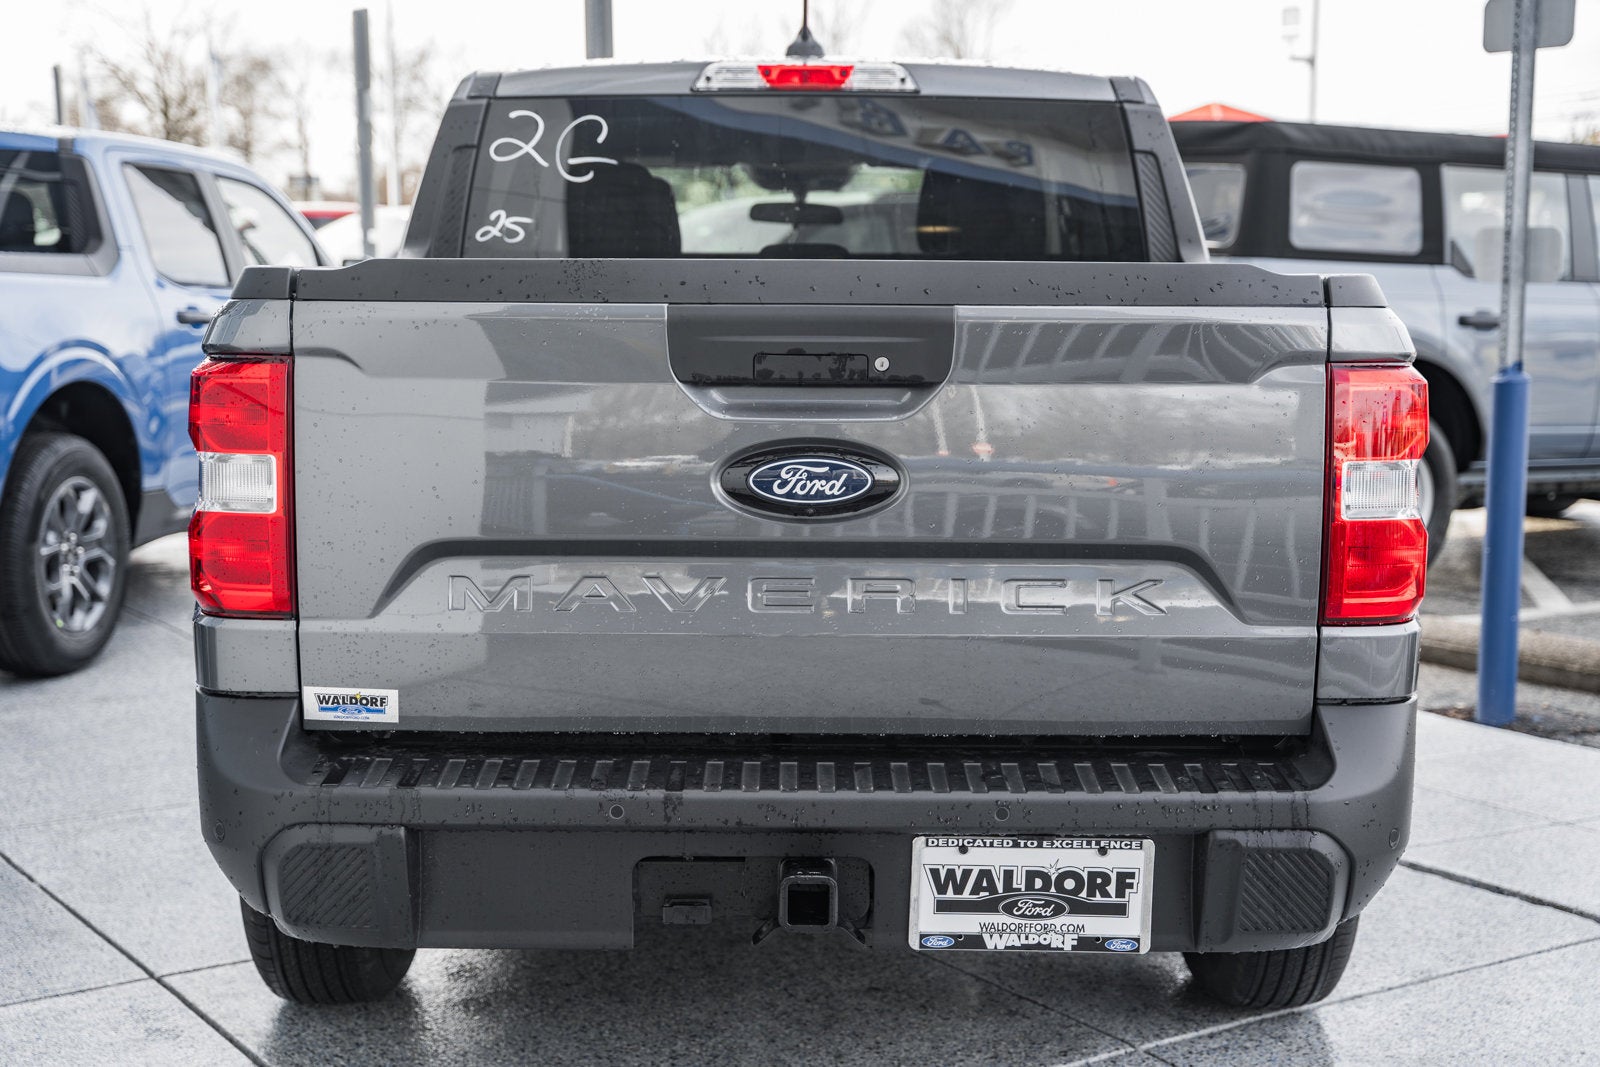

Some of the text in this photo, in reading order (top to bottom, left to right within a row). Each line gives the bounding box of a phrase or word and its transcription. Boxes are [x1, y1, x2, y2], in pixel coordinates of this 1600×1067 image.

[475, 209, 535, 243] 25
[773, 464, 849, 496] Ford
[448, 575, 1167, 616] MAVERICK
[316, 694, 387, 707] WALDORF
[928, 838, 1141, 850] DEDICATED TO EXCELLENCE
[928, 867, 1137, 898] WALDORF
[1013, 899, 1054, 917] Ford
[979, 922, 1085, 934] WALDORFFORD.COM
[927, 935, 949, 946] Ford
[982, 932, 1078, 951] WALDORF
[1110, 940, 1132, 950] Ford
